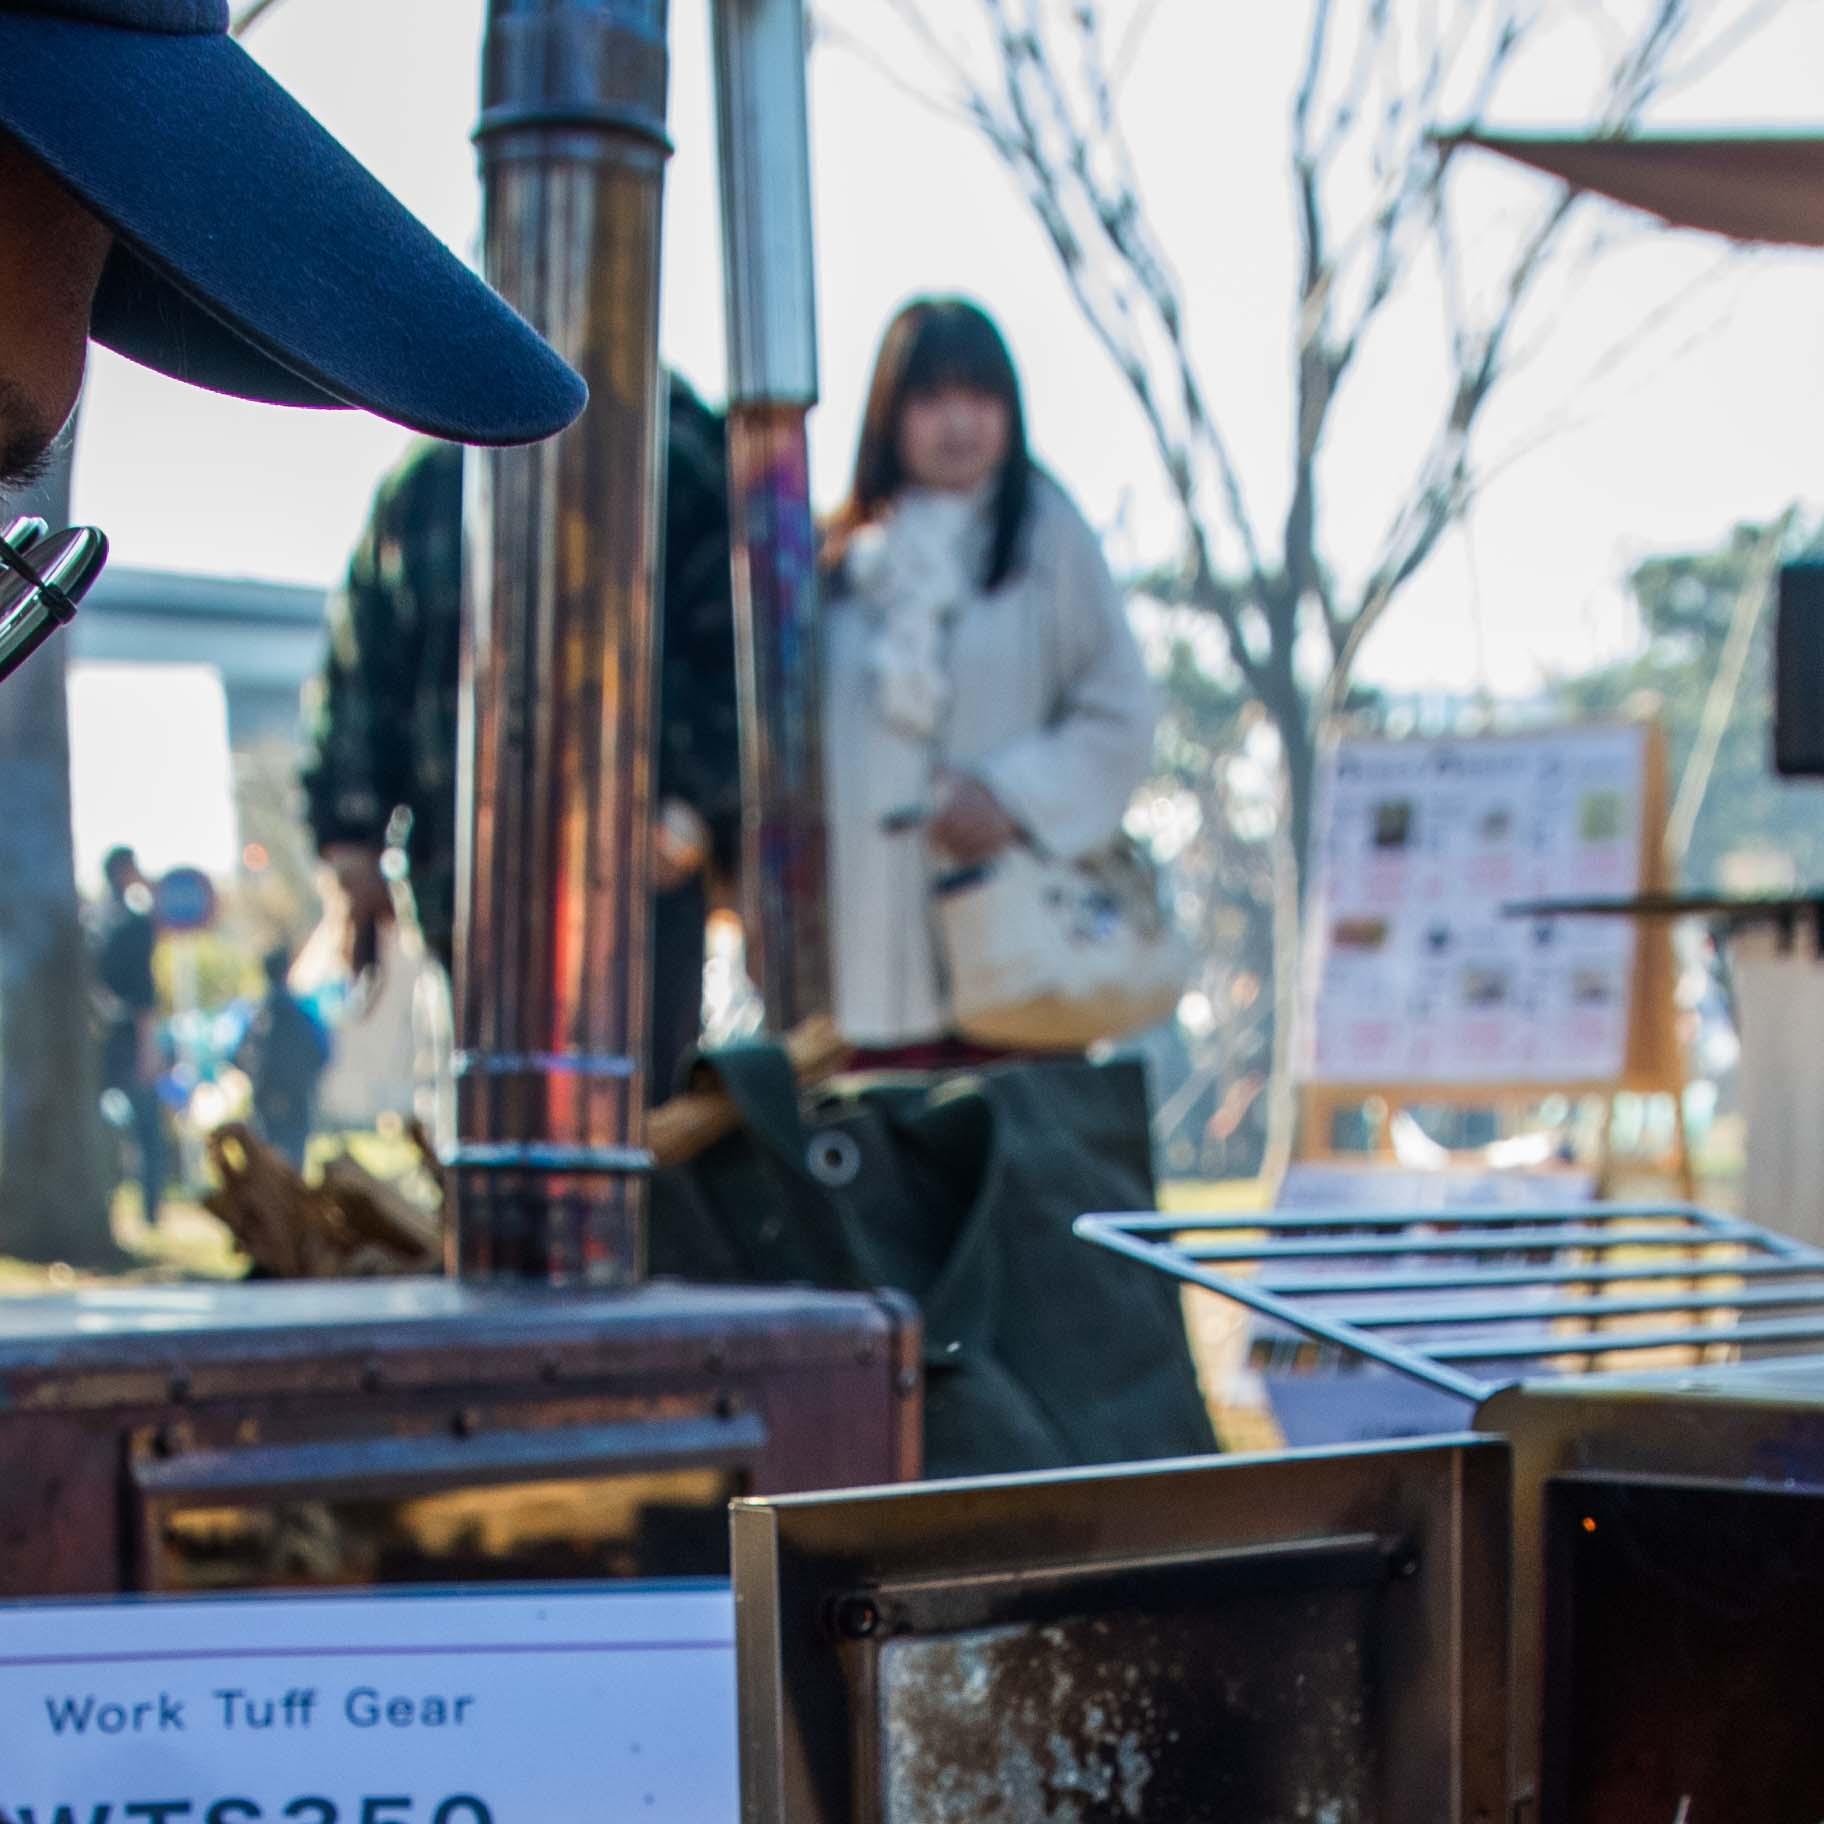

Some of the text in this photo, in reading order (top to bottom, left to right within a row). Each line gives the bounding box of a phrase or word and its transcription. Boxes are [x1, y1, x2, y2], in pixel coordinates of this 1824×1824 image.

[44, 1686, 474, 1735] Work Tuff Gear
